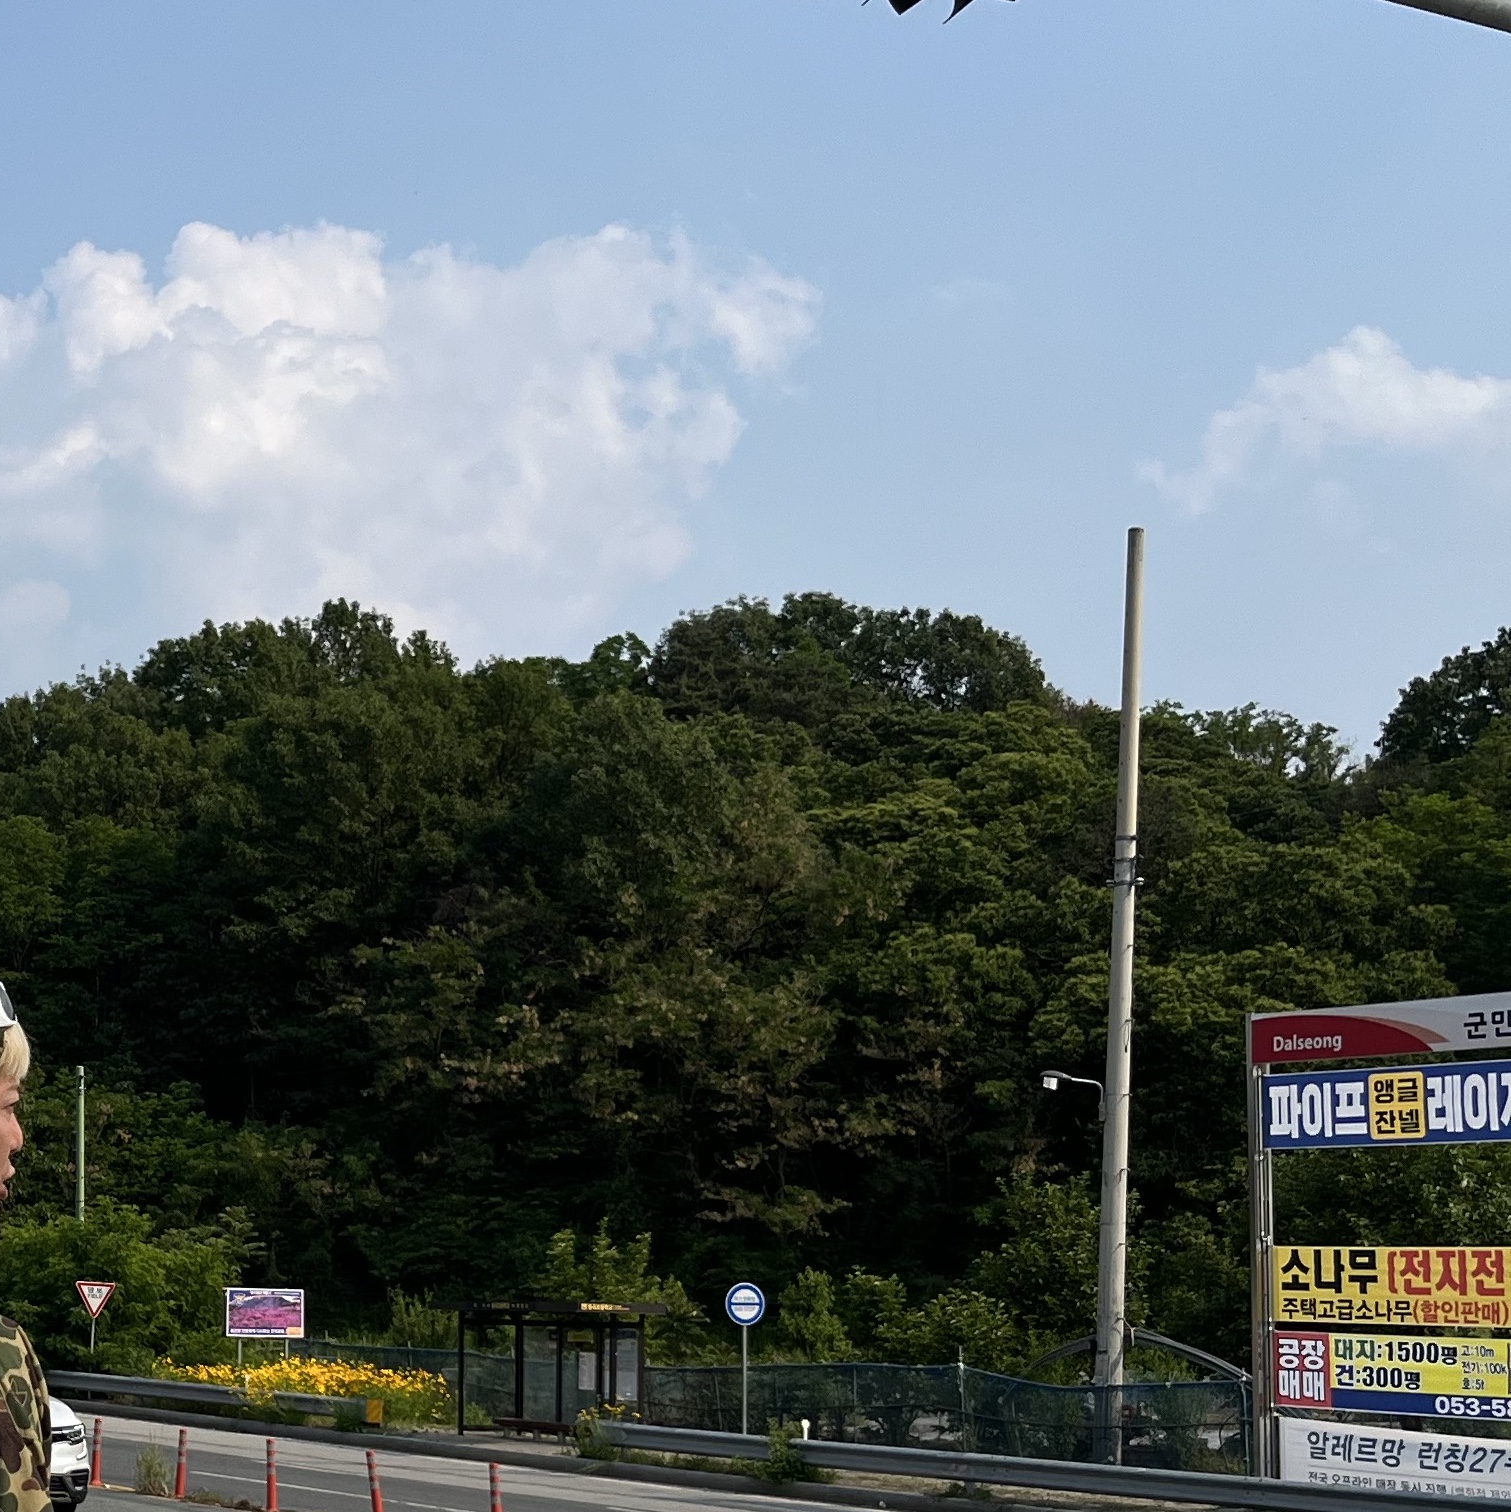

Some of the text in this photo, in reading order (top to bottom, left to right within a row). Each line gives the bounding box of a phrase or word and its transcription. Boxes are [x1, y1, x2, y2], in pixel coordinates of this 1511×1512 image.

[1272, 1034, 1342, 1052] Dalseong
[1374, 1077, 1418, 1104] 앵글
[1269, 1081, 1368, 1139] 파이프
[1375, 1109, 1420, 1135] 잔넬
[1281, 1249, 1378, 1294] 소나무
[1278, 1338, 1325, 1370] 공장
[1278, 1370, 1325, 1401] 매매
[1307, 1431, 1406, 1468] 알레르망
